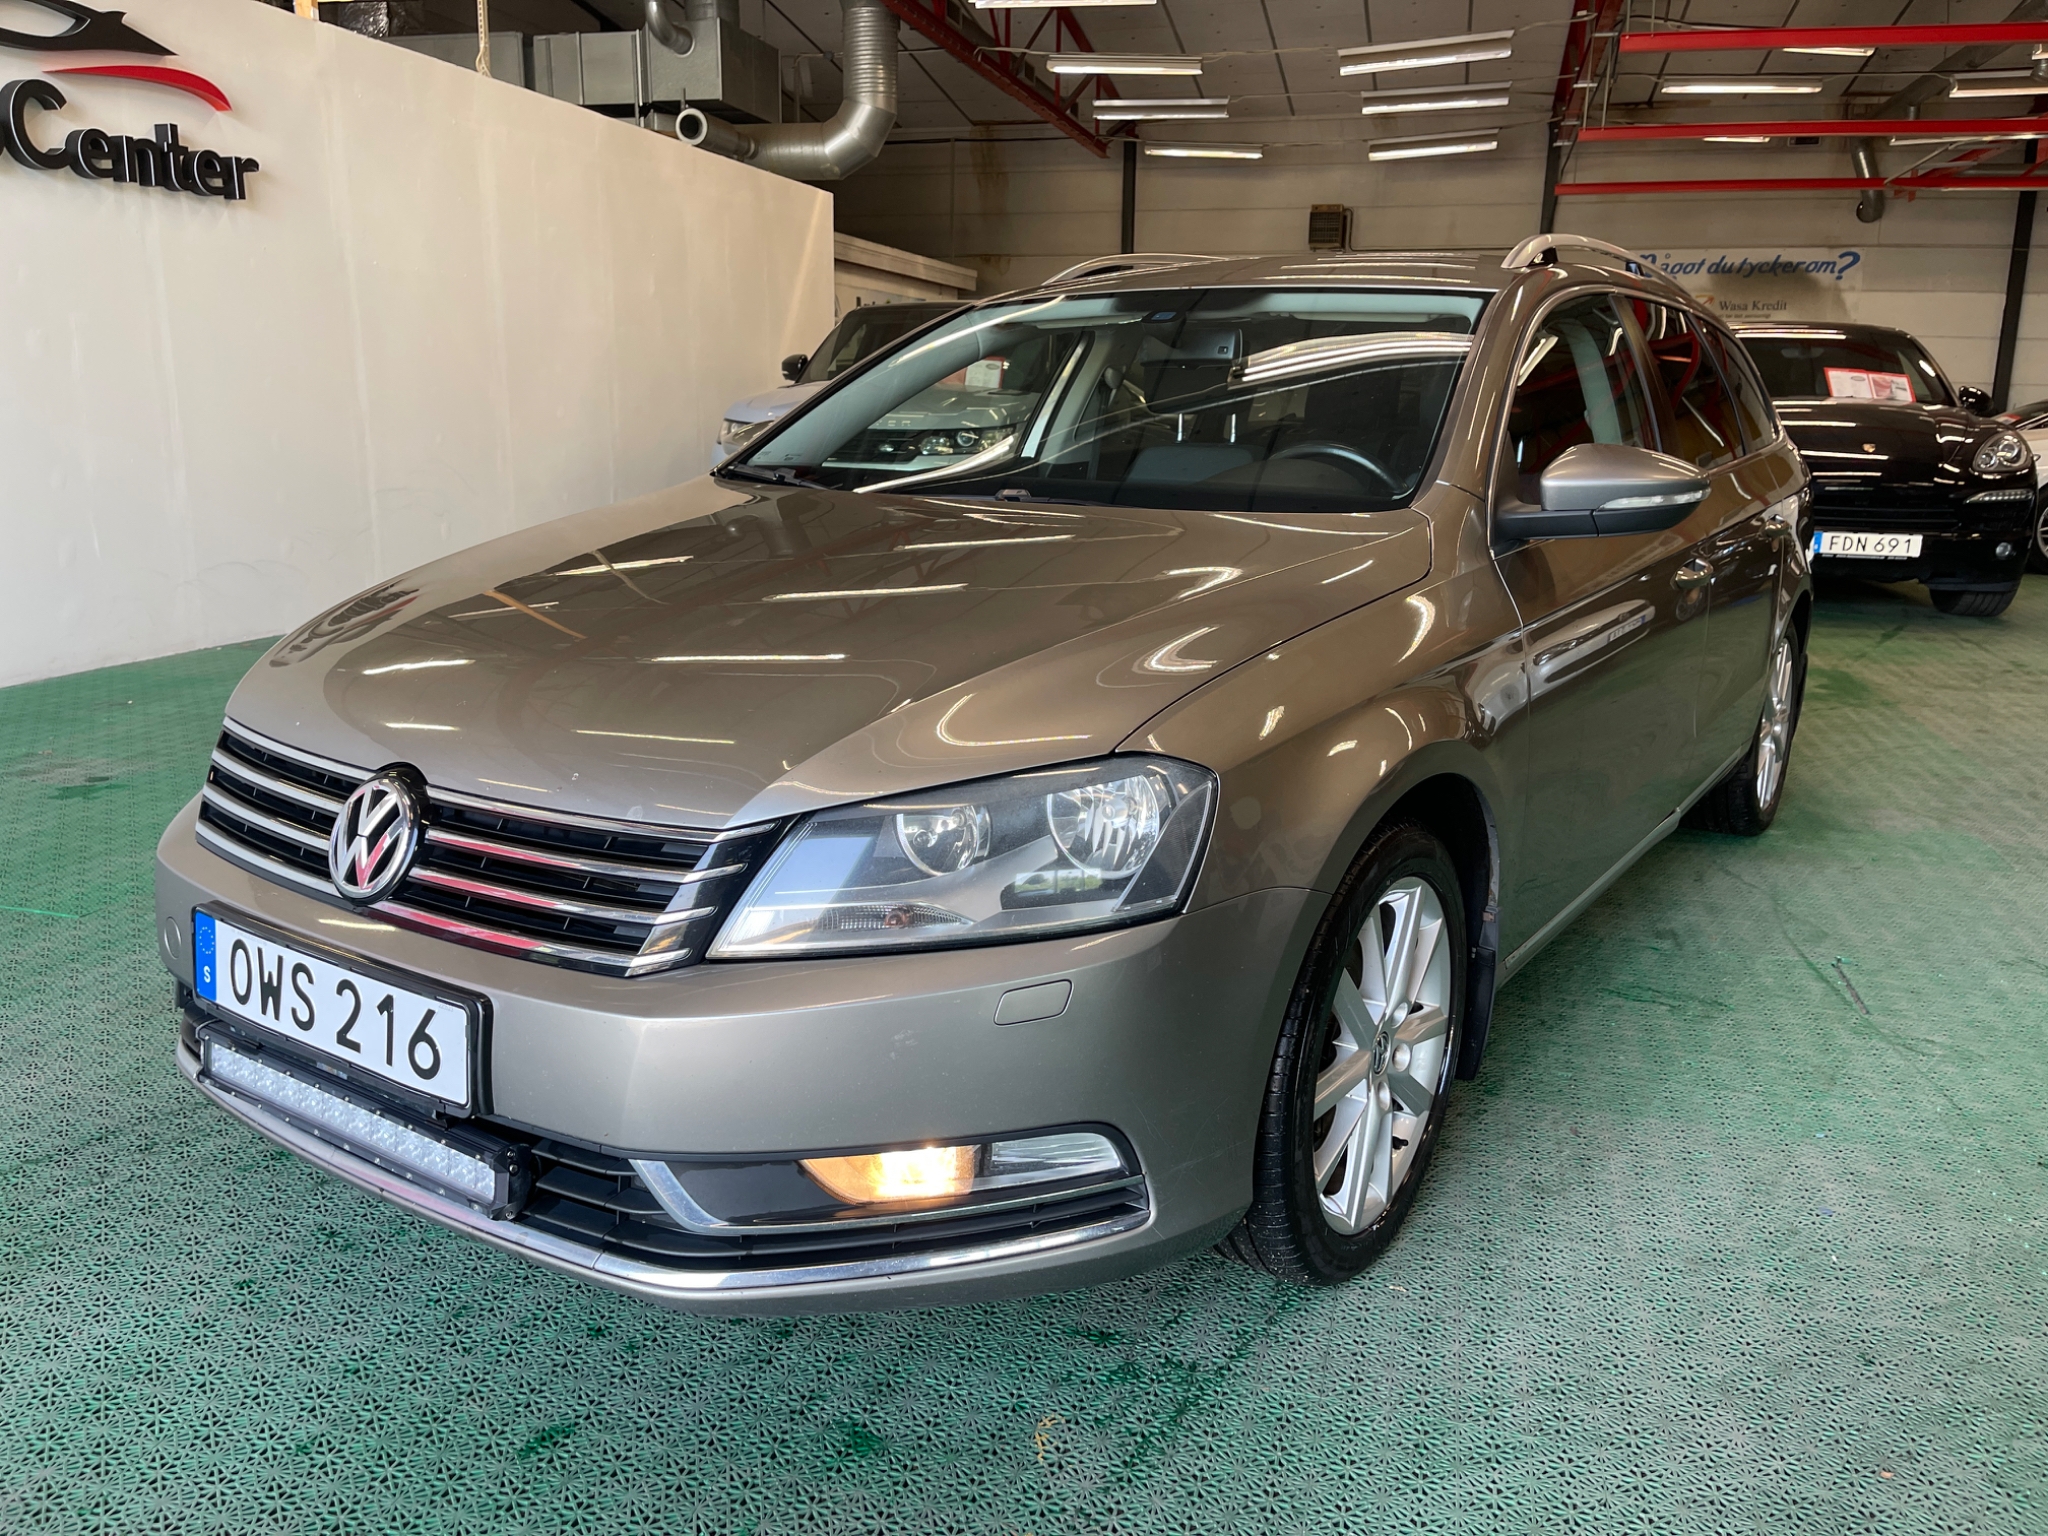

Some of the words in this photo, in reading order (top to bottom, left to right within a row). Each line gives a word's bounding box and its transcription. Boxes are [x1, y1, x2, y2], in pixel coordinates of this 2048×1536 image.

[0, 79, 260, 200] Center
[1707, 255, 1735, 275] du
[1719, 301, 1748, 311] Wasa
[1751, 300, 1787, 311] Kredit
[1829, 535, 1867, 552] FDN
[1874, 537, 1912, 553] 691
[203, 965, 211, 983] S
[229, 938, 315, 1032] OWS
[335, 979, 442, 1081] 216
